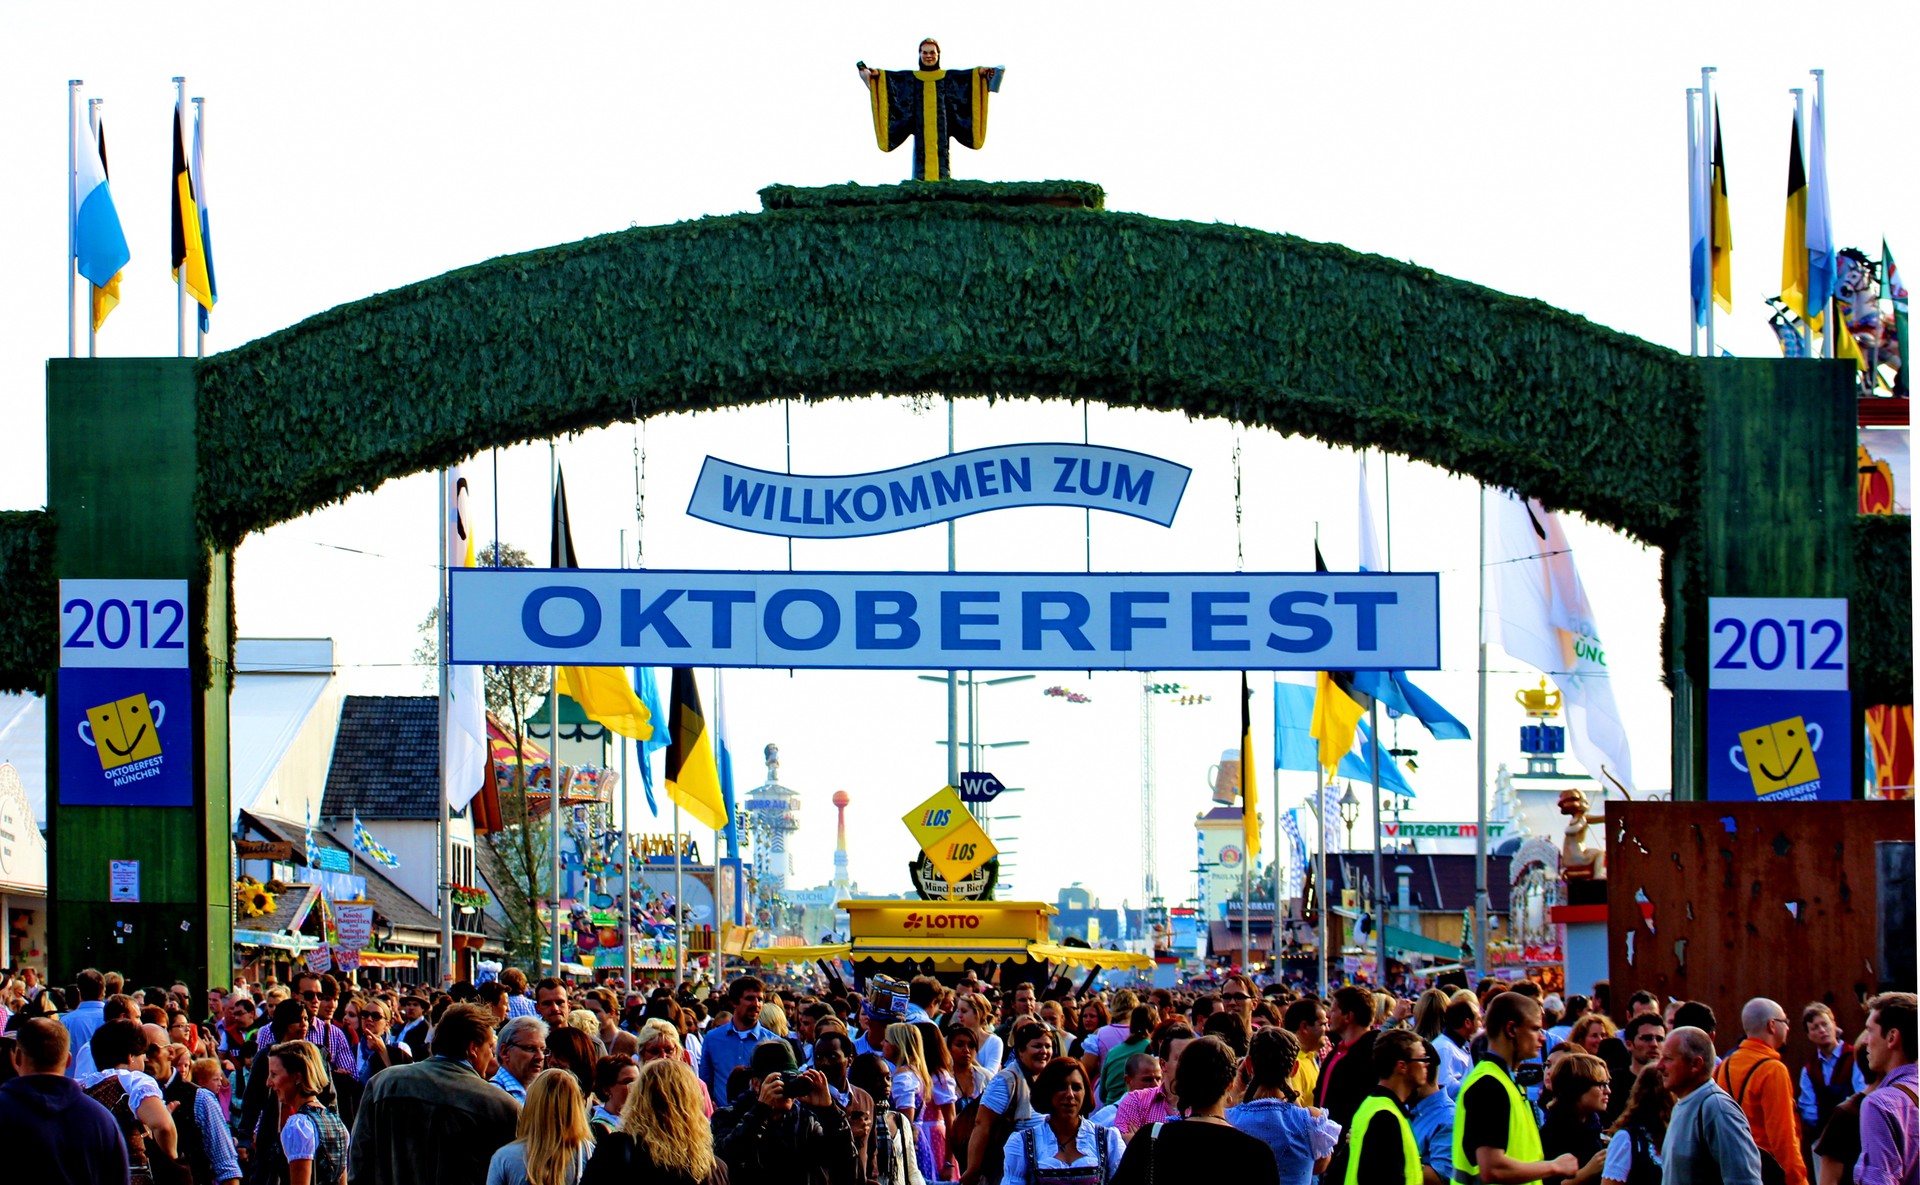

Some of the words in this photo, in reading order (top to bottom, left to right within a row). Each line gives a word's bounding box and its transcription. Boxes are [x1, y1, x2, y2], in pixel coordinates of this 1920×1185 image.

[723, 457, 1032, 525] WILLKOMMEN
[1053, 457, 1155, 506] ZUM
[63, 599, 185, 650] 2012
[522, 586, 1398, 653] OKTOBERFEST
[1714, 618, 1844, 671] 2012
[104, 756, 164, 779] OKTOBERFEST
[113, 767, 161, 787] MÜNCHEN
[963, 779, 997, 796] WC
[1757, 780, 1821, 802] OKTOBERFEST
[926, 809, 952, 827] LOS
[1385, 824, 1505, 837] vinzenzmrr
[952, 843, 977, 860] LOS
[967, 883, 984, 893] Bier
[926, 915, 980, 929] LOTTO
